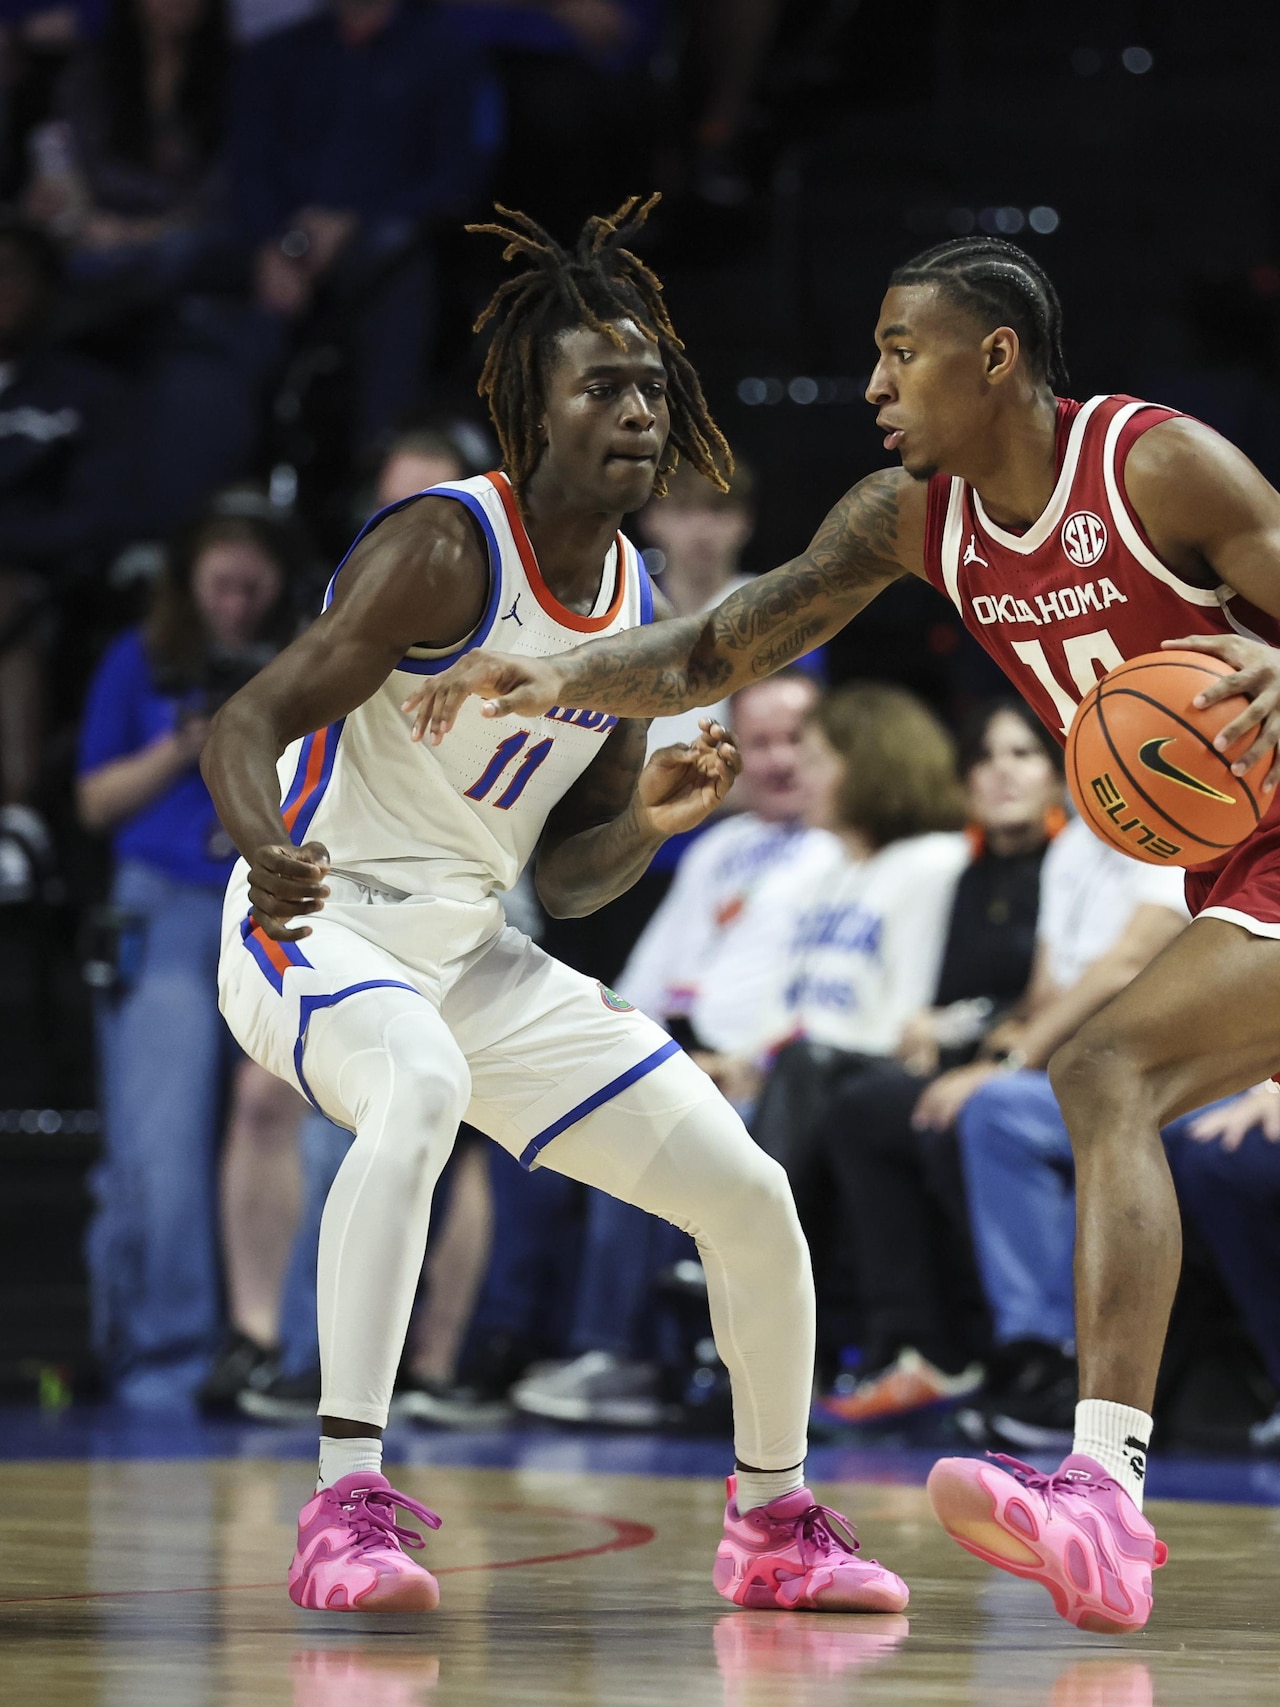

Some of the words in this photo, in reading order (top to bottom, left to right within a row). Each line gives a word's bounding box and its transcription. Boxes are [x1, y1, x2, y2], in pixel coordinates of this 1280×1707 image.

[1065, 514, 1105, 563] SEC
[971, 577, 1129, 626] OKLAHOMA
[463, 730, 554, 811] 11
[1090, 772, 1182, 859] ELITE
